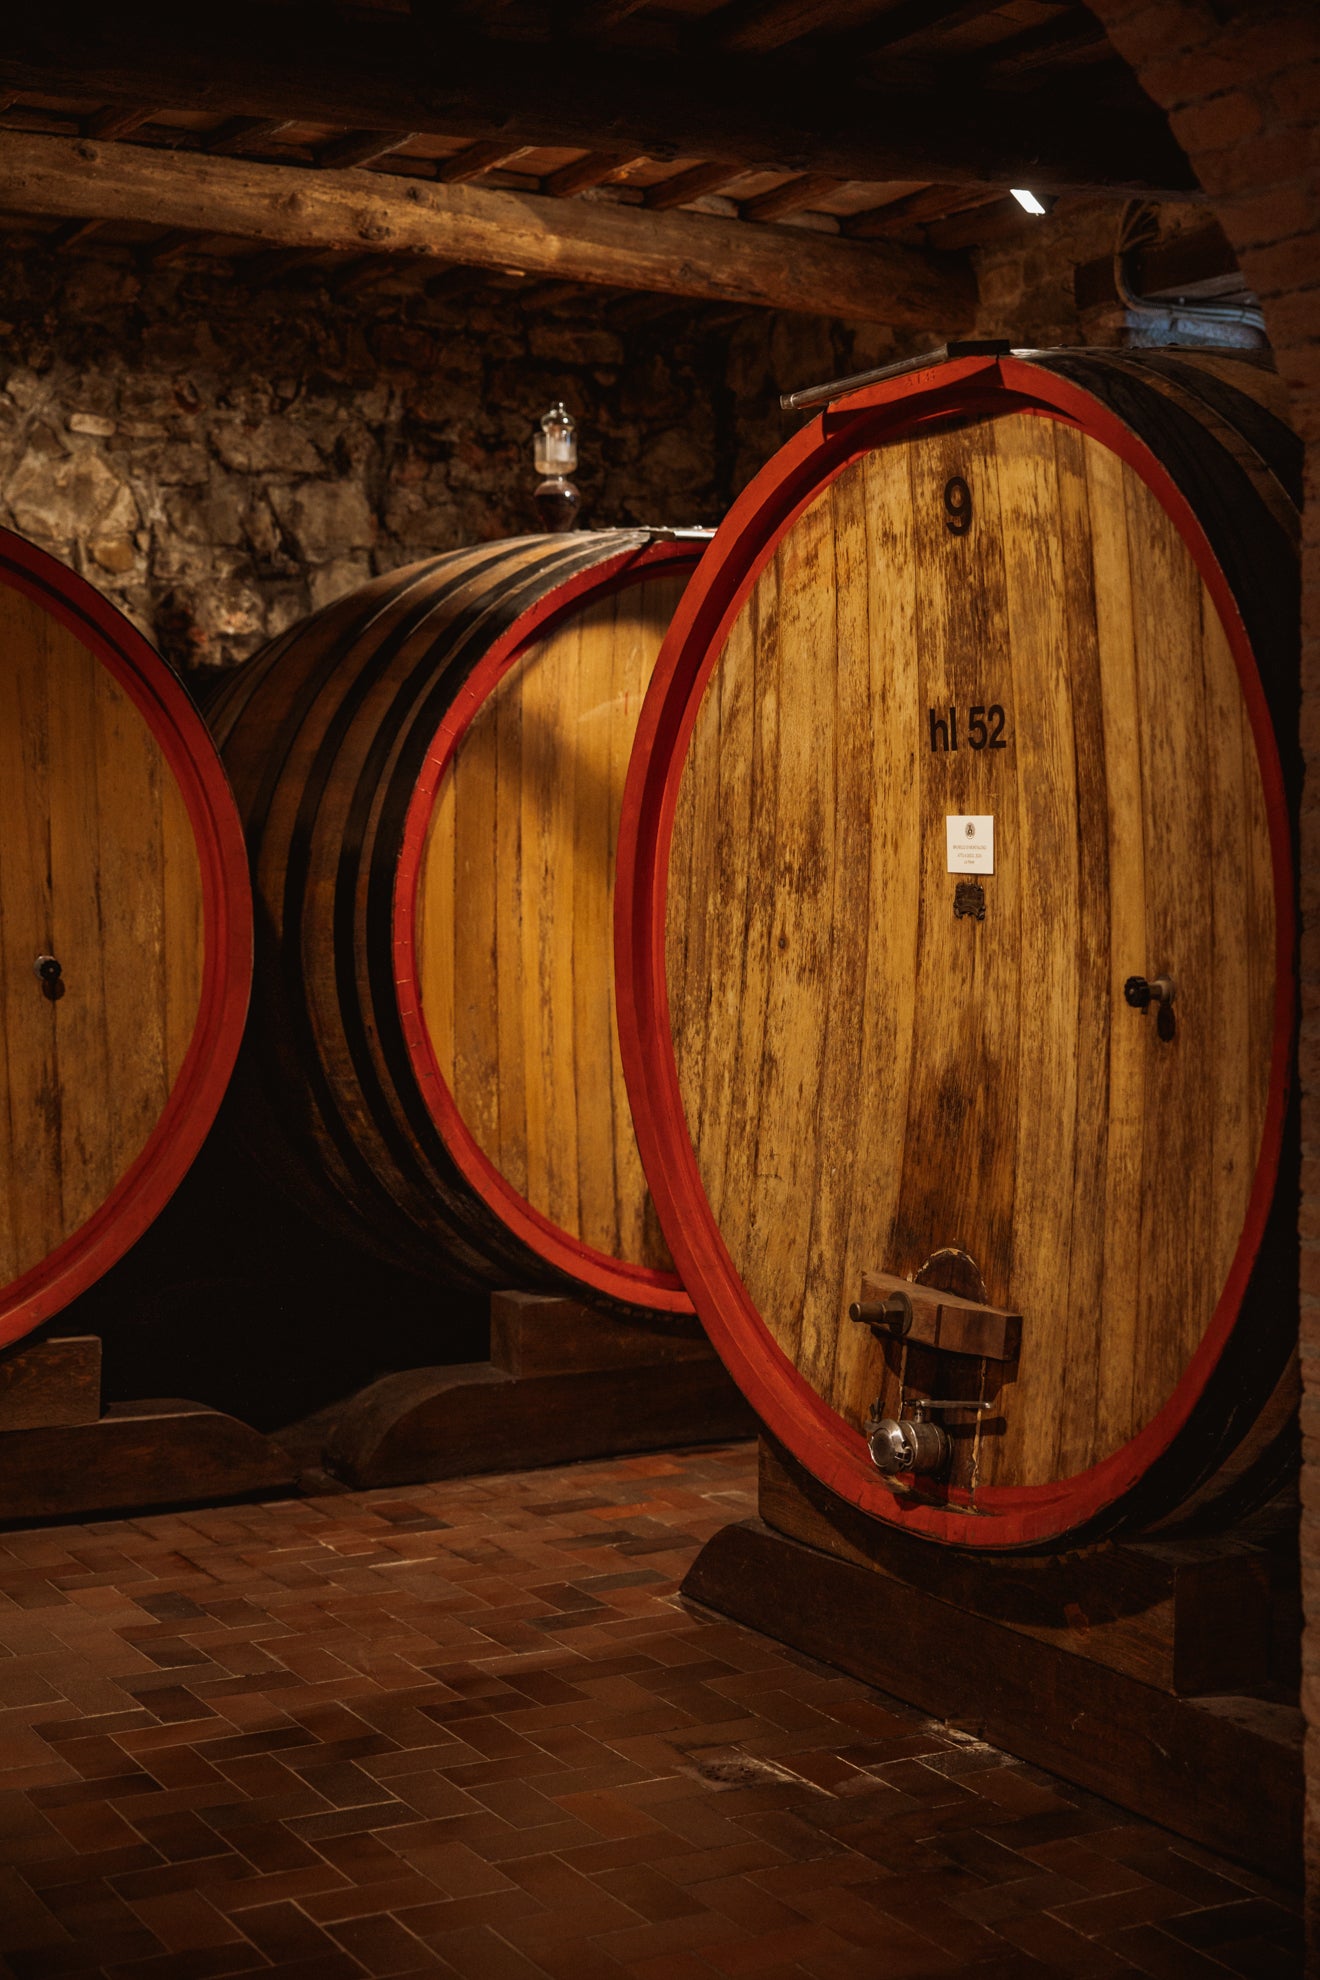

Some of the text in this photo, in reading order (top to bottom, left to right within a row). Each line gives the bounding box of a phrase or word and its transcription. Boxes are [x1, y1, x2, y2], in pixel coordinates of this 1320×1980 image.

[944, 477, 972, 536] 9
[930, 705, 1006, 752] hl 52
